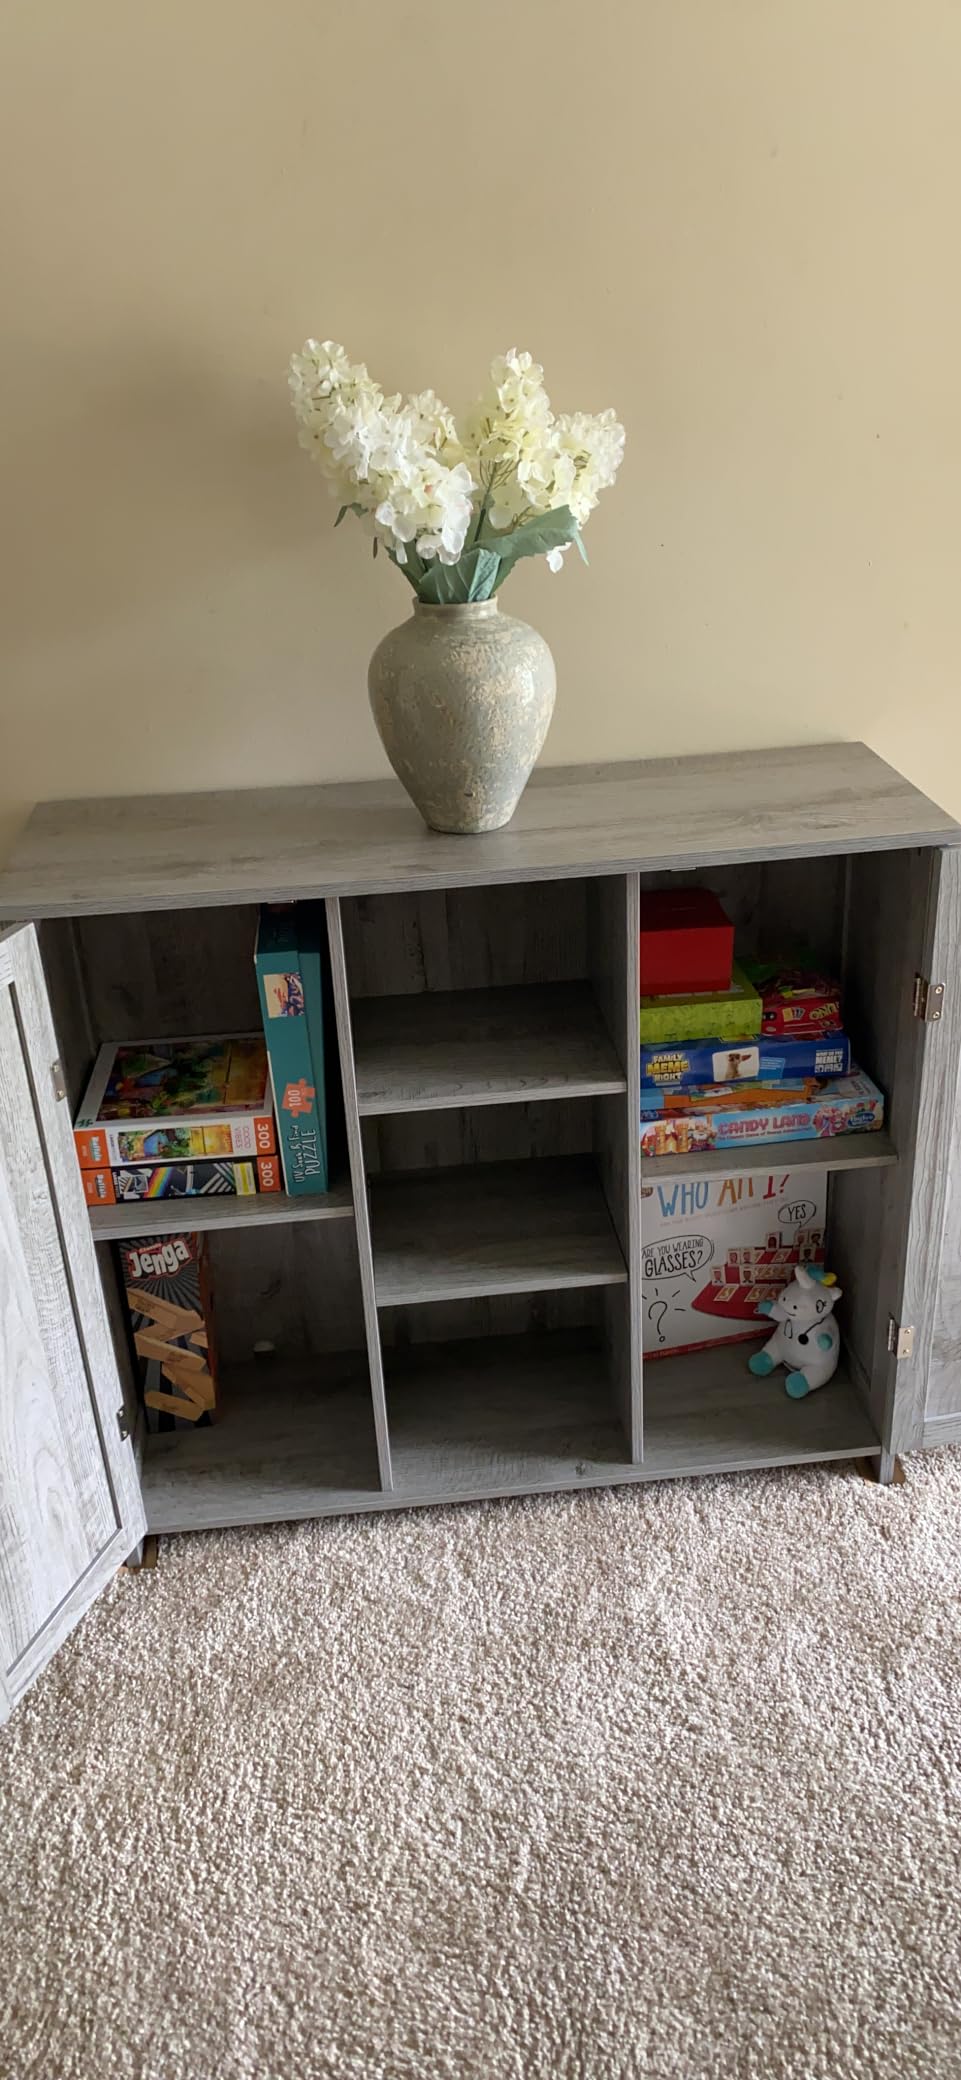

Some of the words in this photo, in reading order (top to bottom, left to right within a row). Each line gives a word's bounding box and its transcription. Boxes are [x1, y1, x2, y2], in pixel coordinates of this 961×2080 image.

[646, 1061, 690, 1077] MEME
[287, 1089, 302, 1108] 100
[257, 1123, 271, 1149] 300
[718, 1118, 769, 1136] CANDY
[773, 1112, 810, 1130] LAND
[300, 1129, 321, 1175] PUZZLE
[260, 1162, 274, 1187] 300
[656, 1181, 709, 1218] WHO
[788, 1203, 806, 1222] YES
[129, 1240, 190, 1278] Jenga
[641, 1247, 654, 1260] ARE
[657, 1244, 672, 1256] YOU
[672, 1238, 704, 1253] WEARING
[644, 1250, 703, 1277] GLASSES?
